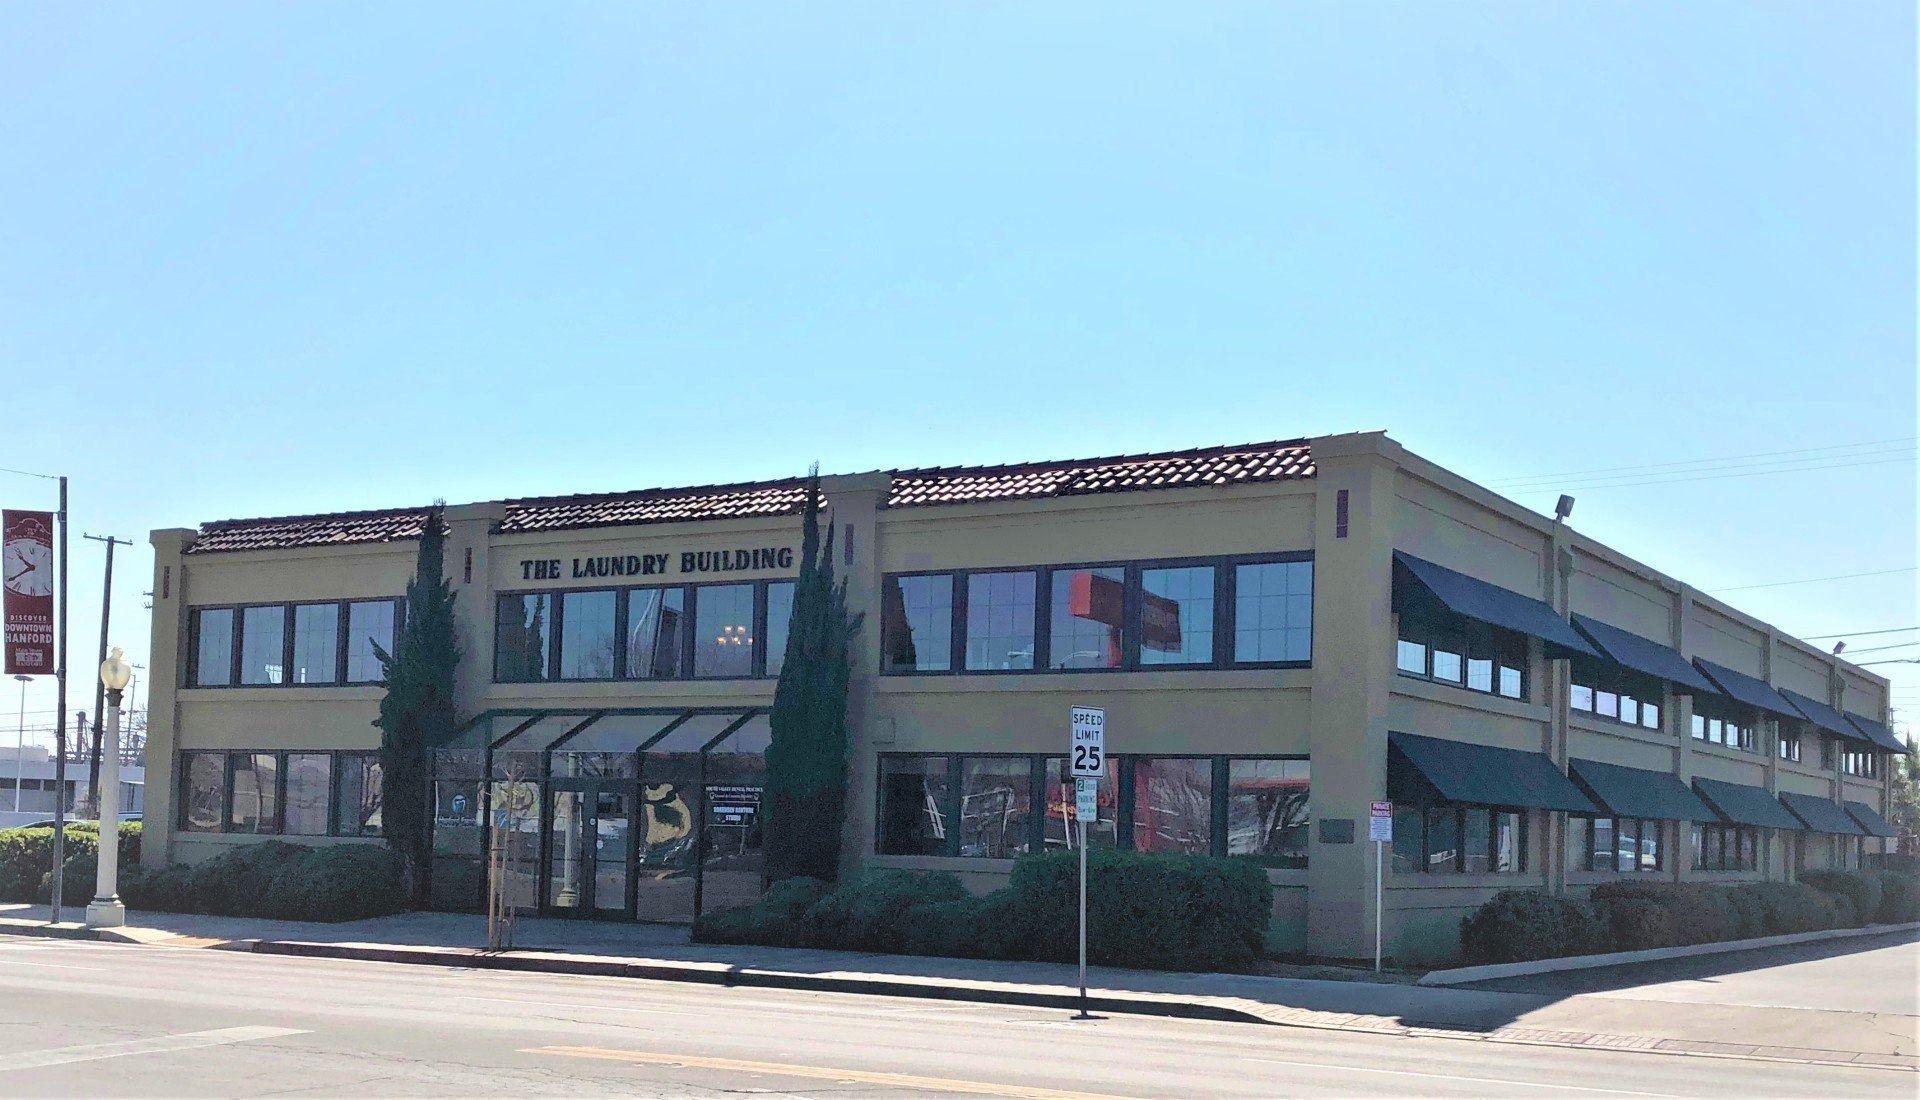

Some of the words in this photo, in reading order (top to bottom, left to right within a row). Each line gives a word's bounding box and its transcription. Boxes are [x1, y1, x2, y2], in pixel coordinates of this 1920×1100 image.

[520, 559, 561, 580] THE
[572, 553, 669, 578] LAUNDRY
[680, 547, 793, 573] BUILDING
[4, 623, 53, 632] DOWNTOWN
[5, 632, 53, 644] HANFORD
[1073, 713, 1103, 726] SPEED
[1075, 729, 1100, 741] LIMIT
[1074, 744, 1101, 771] 25
[1078, 780, 1084, 791] 2
